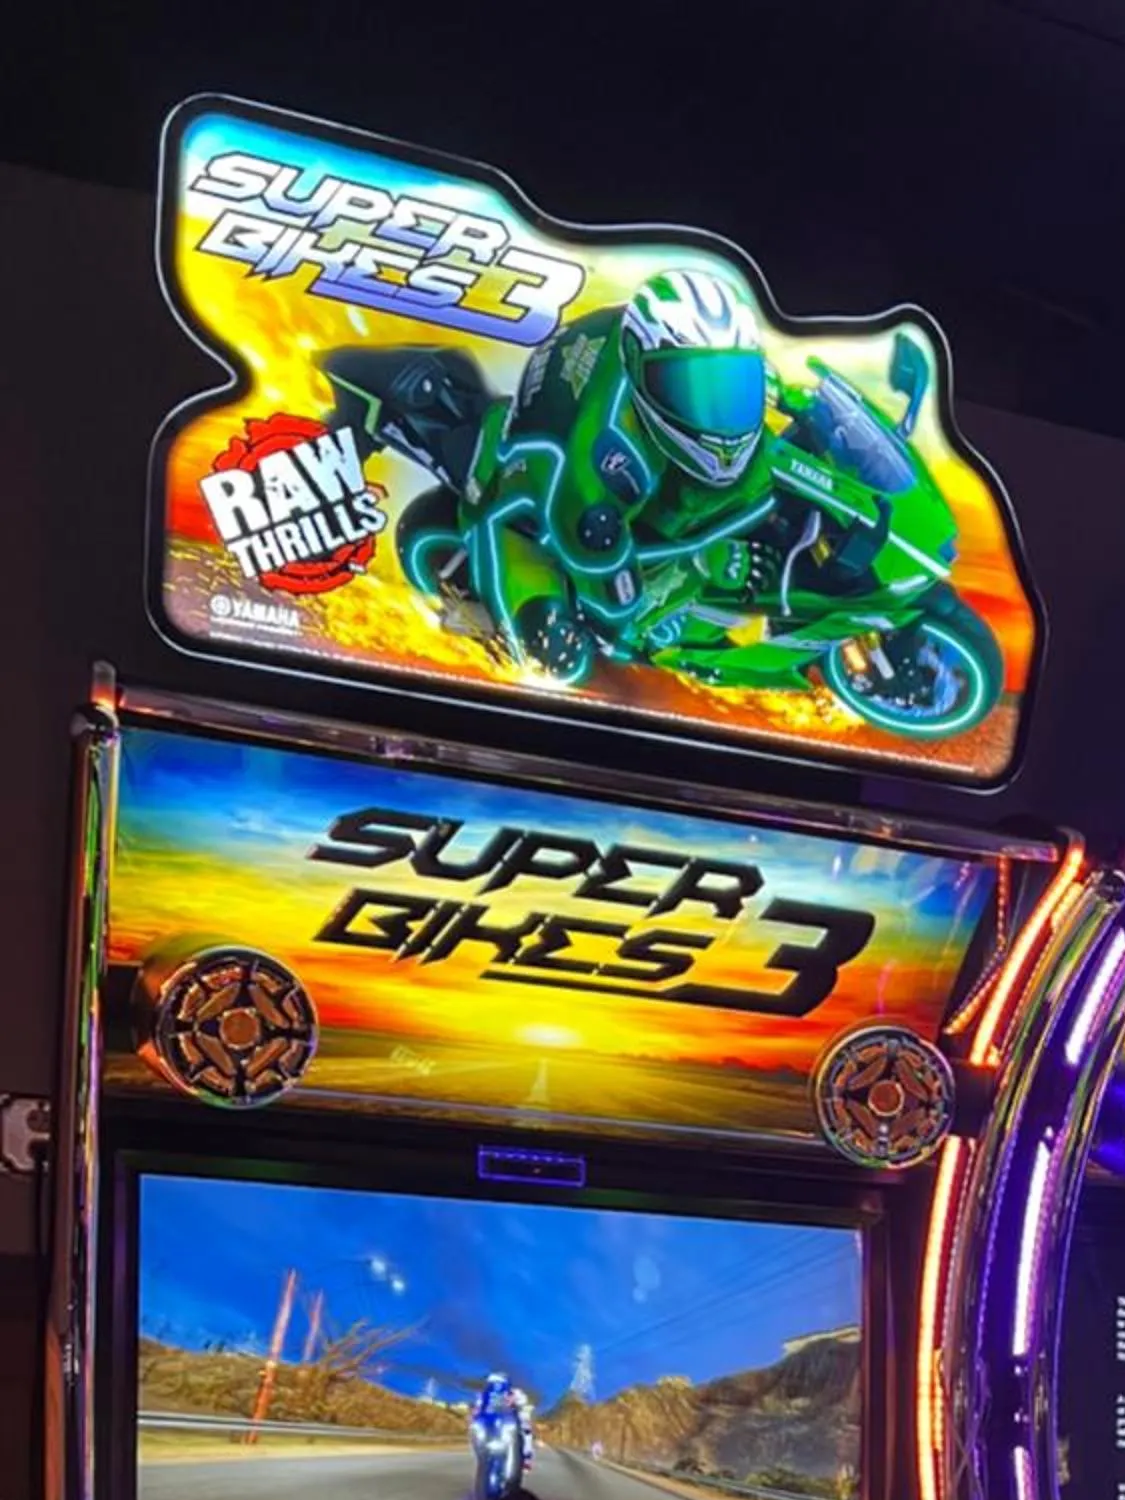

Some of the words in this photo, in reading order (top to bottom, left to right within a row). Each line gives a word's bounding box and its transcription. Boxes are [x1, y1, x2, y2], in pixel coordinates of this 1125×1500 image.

[189, 151, 511, 267] SUPER
[195, 208, 484, 310] BIKES
[199, 426, 366, 540] RAW
[226, 490, 388, 578] THRILLS
[306, 807, 766, 919] SUPER
[312, 886, 715, 983] BIKES
